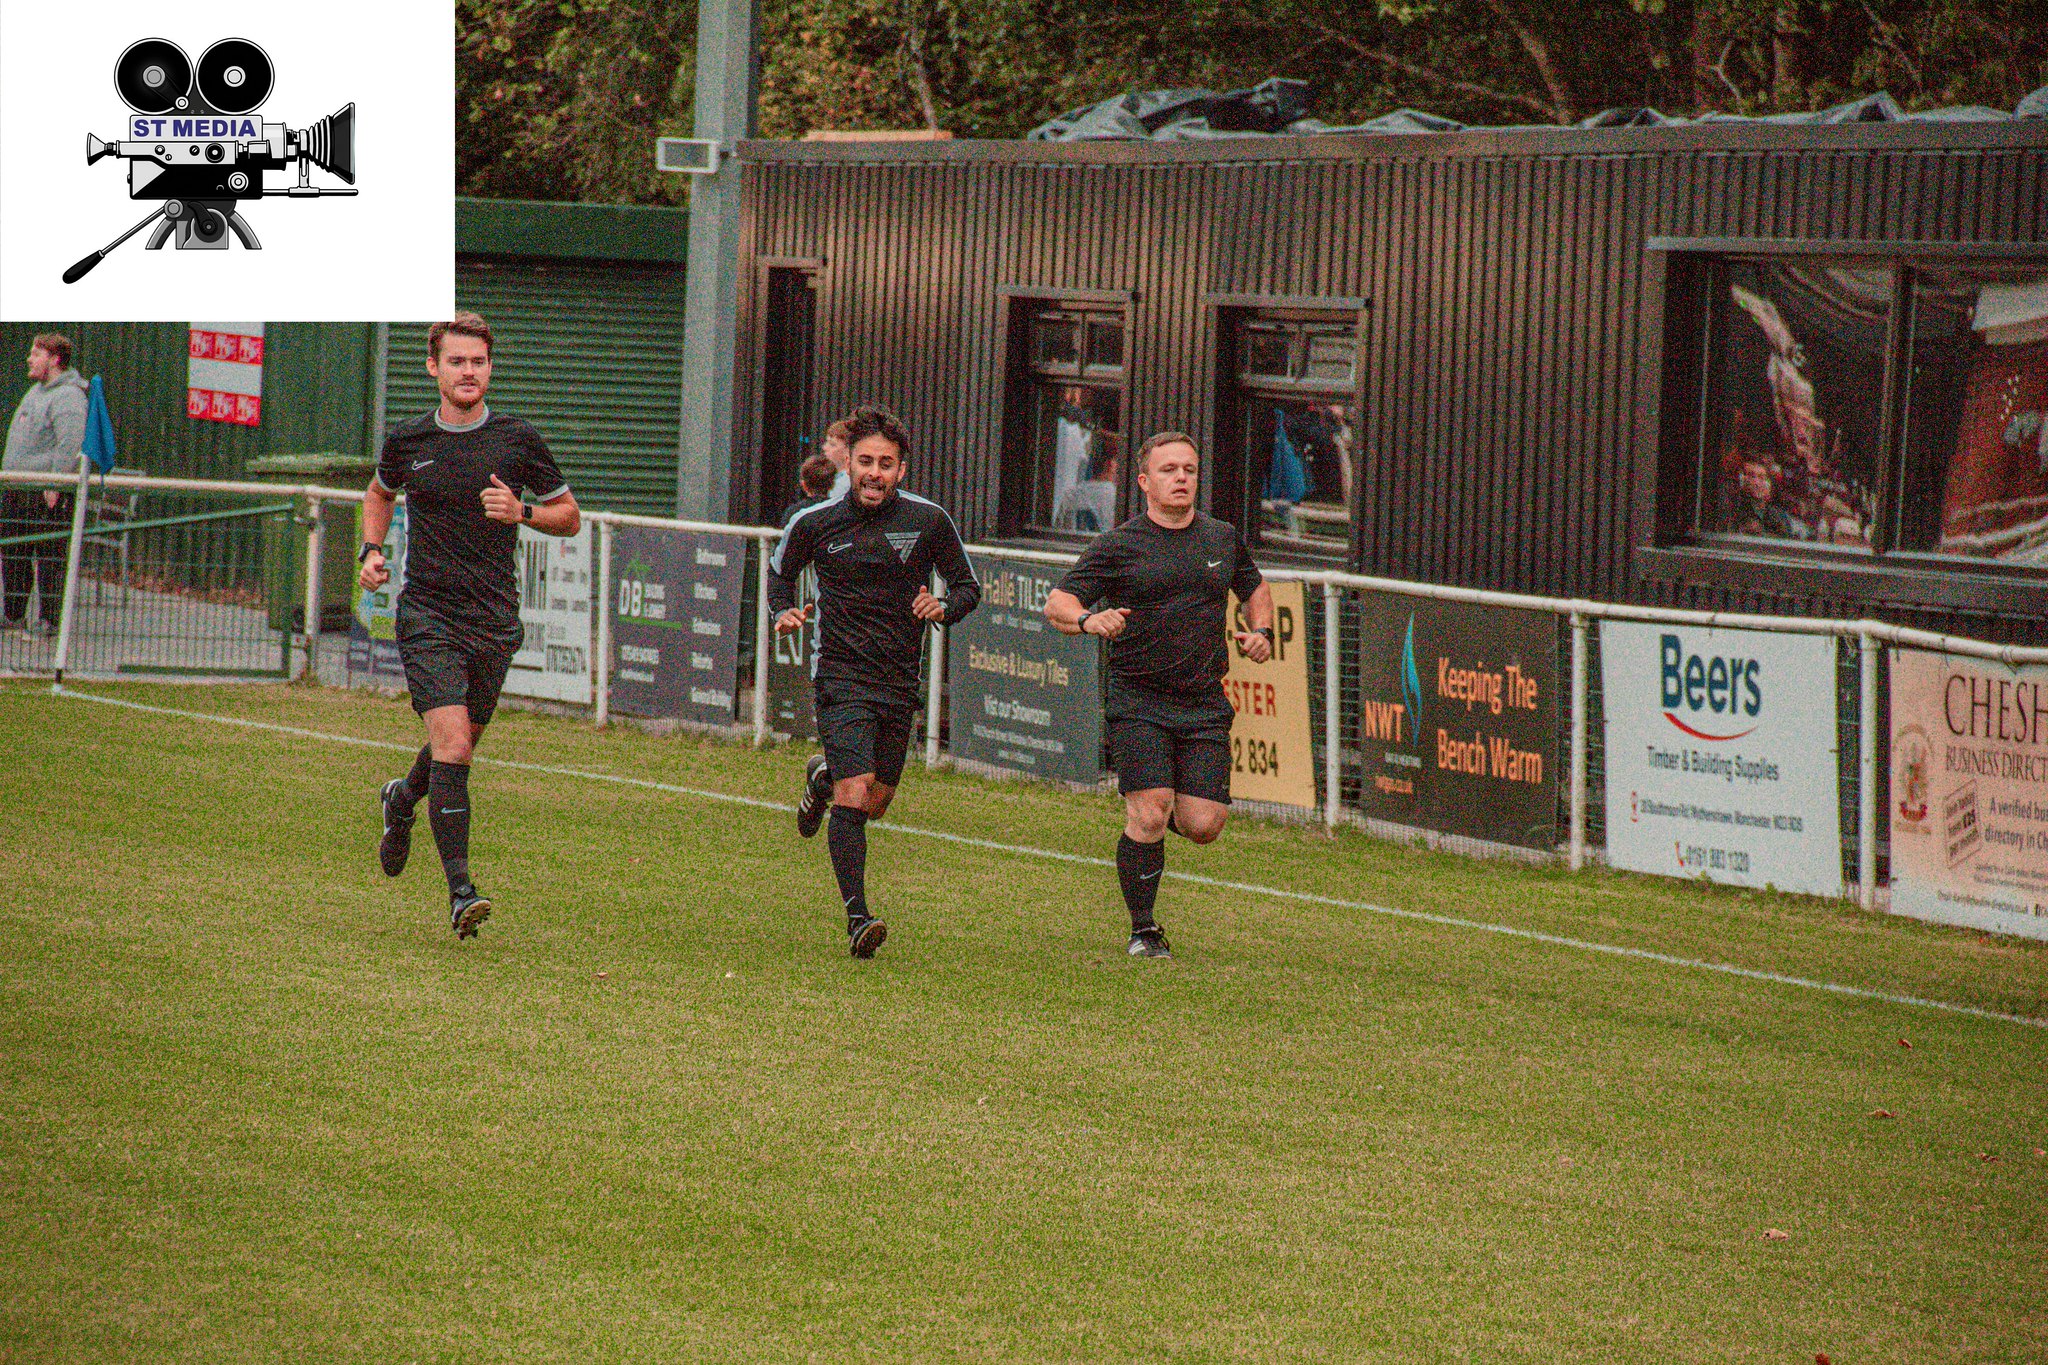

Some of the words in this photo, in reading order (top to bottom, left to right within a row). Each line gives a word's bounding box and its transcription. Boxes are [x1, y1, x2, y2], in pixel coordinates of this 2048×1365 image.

[618, 578, 643, 617] DB
[983, 568, 1015, 607] Hallé
[968, 645, 1009, 675] Exclusive
[1017, 651, 1045, 688] Luxury
[1046, 658, 1069, 687] Tiles
[1438, 656, 1502, 715] Keeping
[1505, 664, 1538, 710] The
[1660, 633, 1762, 717] Beers
[1011, 700, 1051, 727] Showroom
[1364, 699, 1405, 742] NWT
[1944, 674, 2048, 744] CHESH
[1249, 737, 1279, 778] 834
[1437, 728, 1486, 776] Bench
[1490, 736, 1543, 785] Warm
[1647, 746, 1680, 771] Timber
[1681, 749, 1689, 772] &
[1691, 749, 1733, 782] Building
[1734, 754, 1779, 784] Supplies
[1945, 744, 2000, 778] BUSINESS
[1989, 796, 1997, 814] A
[1998, 799, 2032, 819] verified
[1984, 824, 2024, 853] directory
[2026, 829, 2035, 849] in
